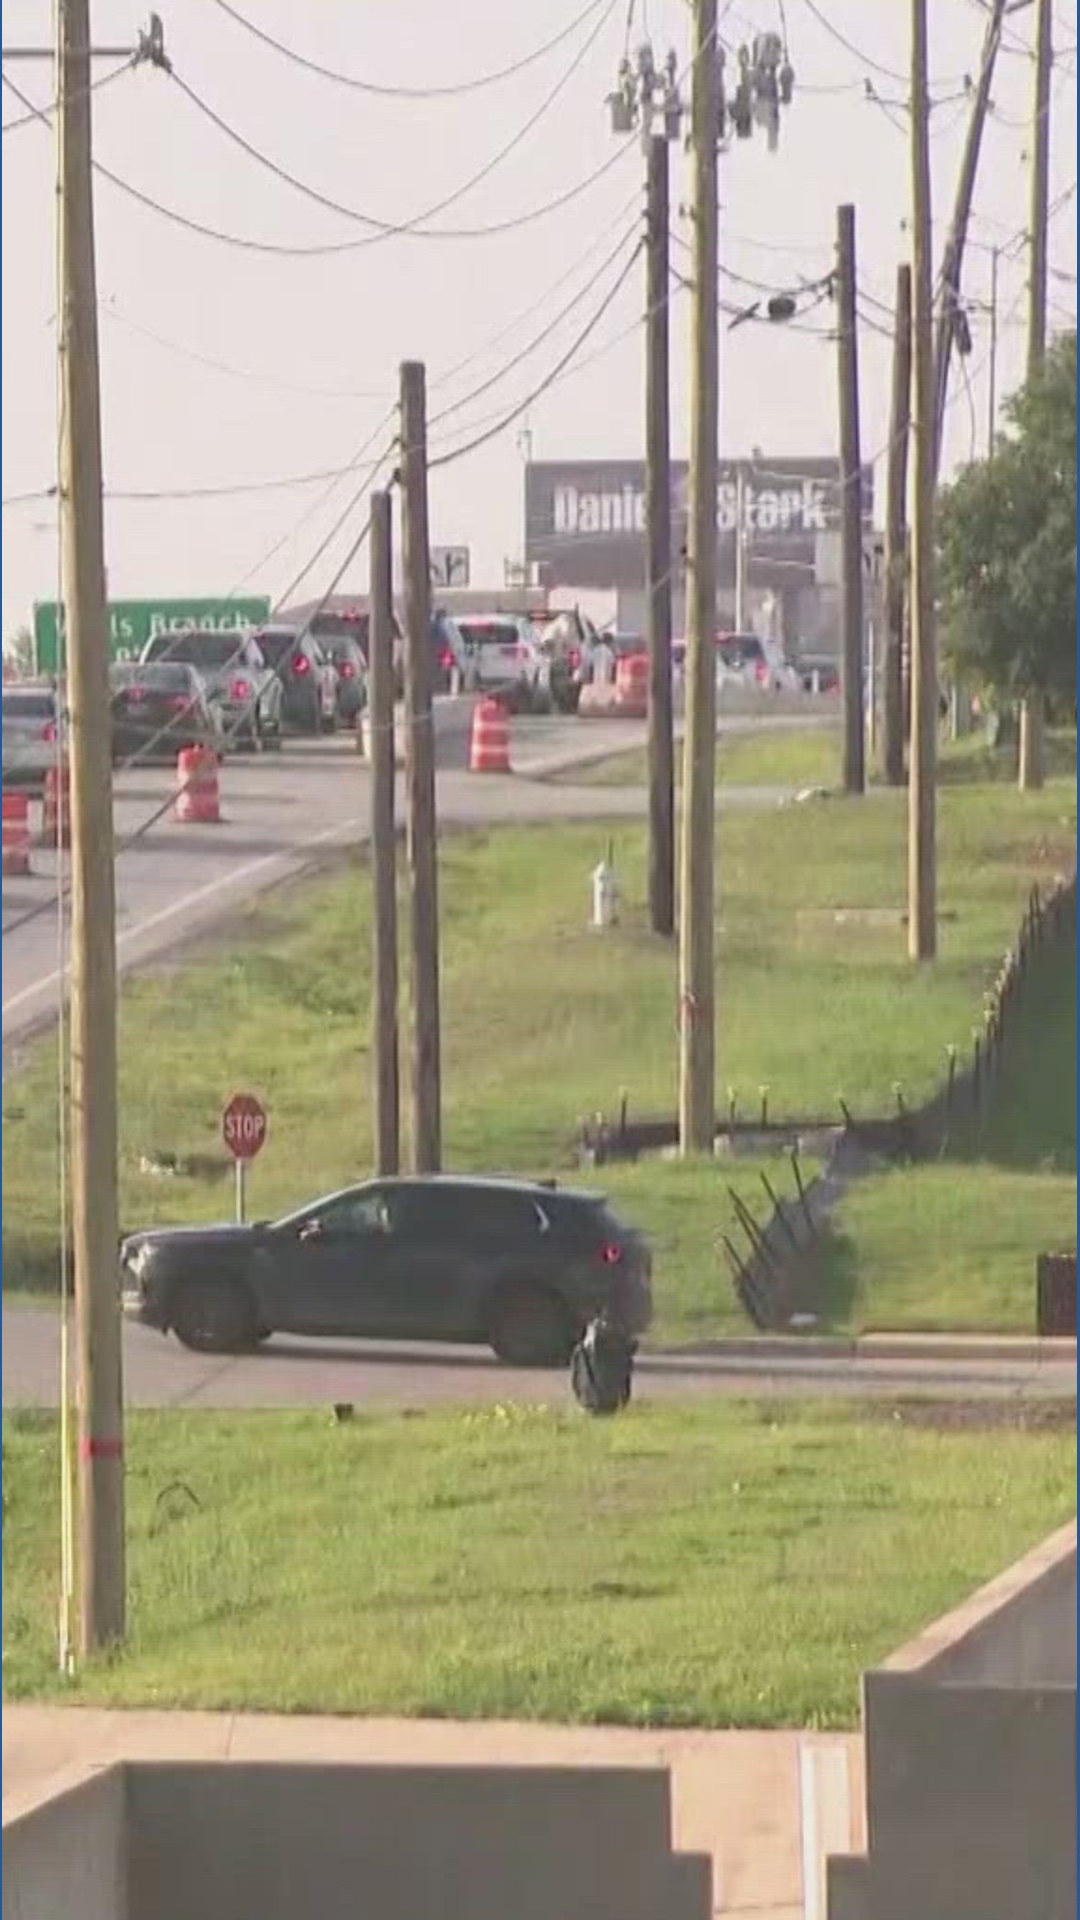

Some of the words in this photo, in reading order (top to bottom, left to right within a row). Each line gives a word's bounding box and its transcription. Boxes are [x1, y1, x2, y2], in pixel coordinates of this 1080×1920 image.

[554, 485, 649, 532] Danie
[716, 480, 826, 532] Stark
[150, 609, 250, 634] Branch
[225, 1114, 263, 1139] STOP
